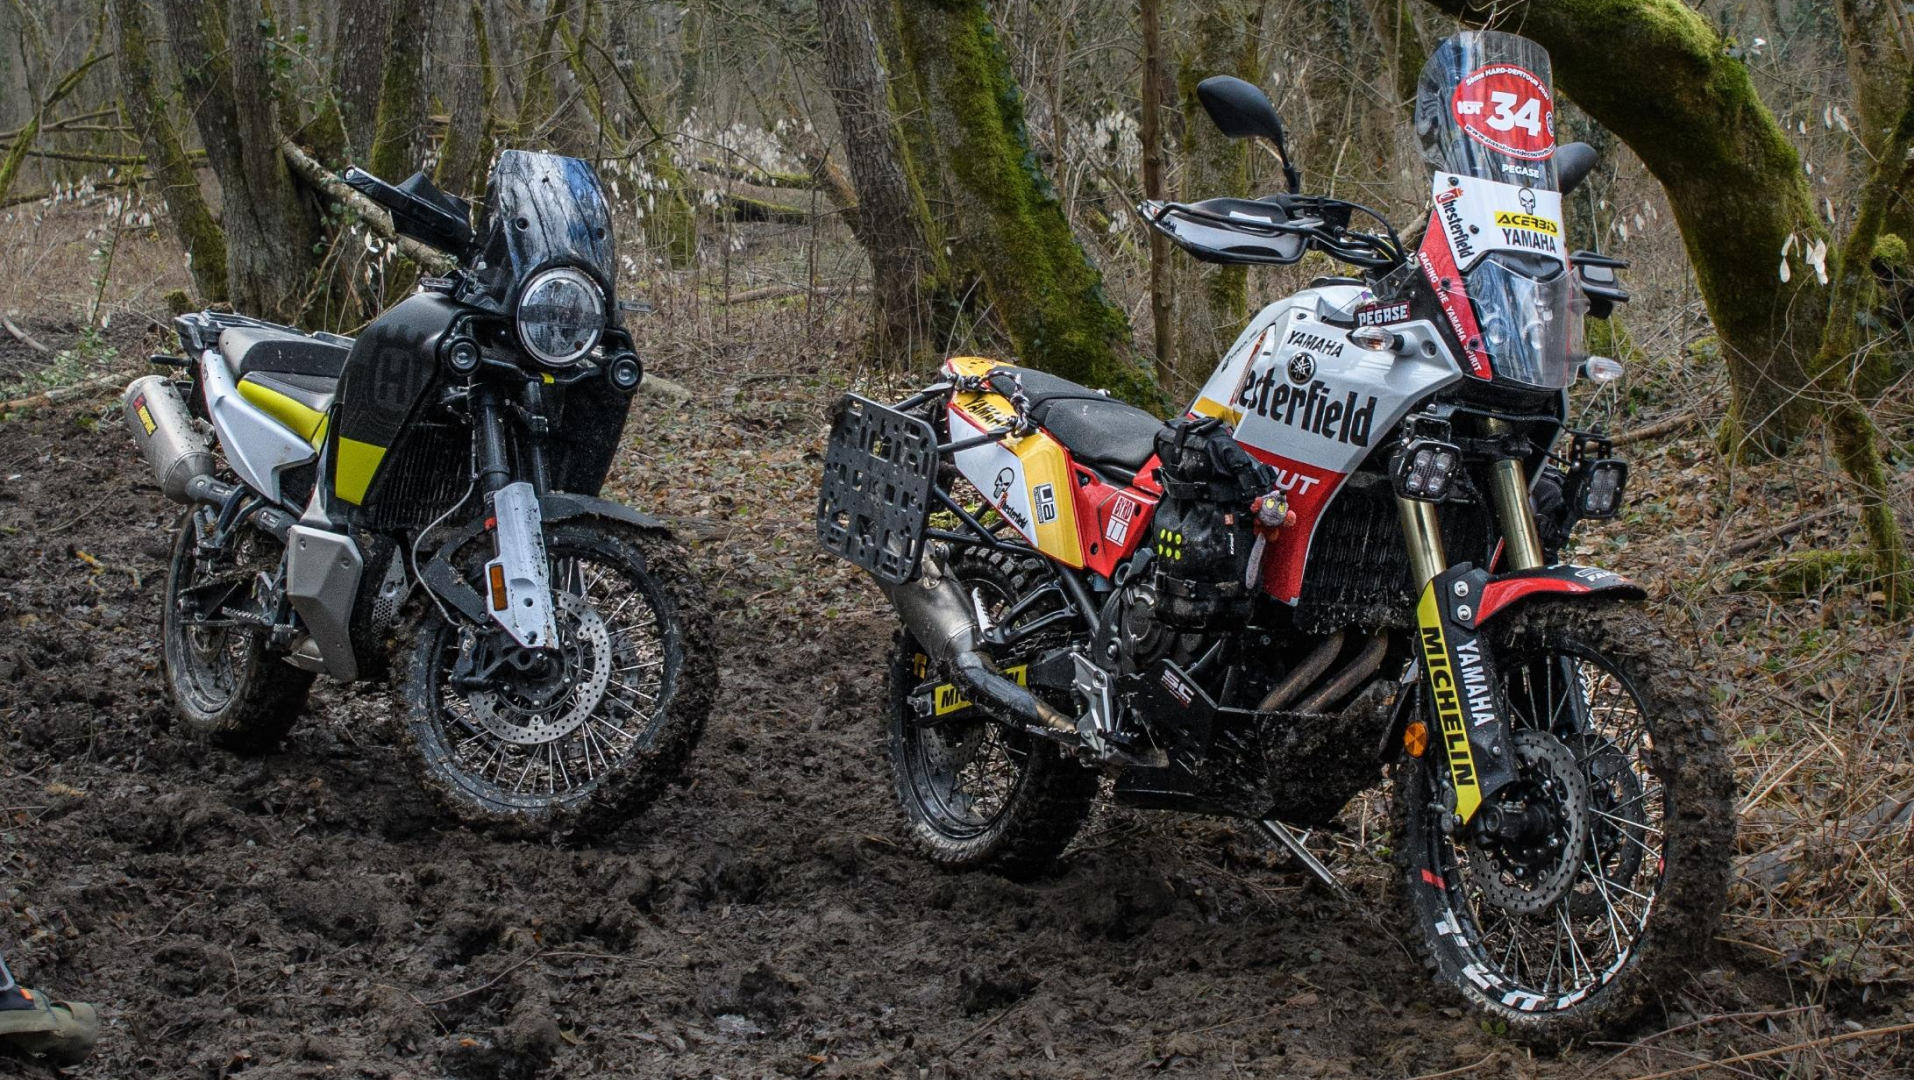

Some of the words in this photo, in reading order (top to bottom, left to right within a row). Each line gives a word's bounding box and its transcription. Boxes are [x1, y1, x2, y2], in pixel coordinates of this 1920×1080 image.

[1485, 91, 1541, 137] 34
[1501, 163, 1540, 179] PEGASE
[1435, 187, 1475, 260] Chesterfield
[1502, 228, 1557, 254] YAMAHA
[1358, 304, 1409, 327] PEGASE
[1419, 252, 1439, 284] RACING
[1436, 287, 1449, 310] THE
[1445, 305, 1467, 342] YAMAHA
[1286, 329, 1345, 359] YAMAHA
[1455, 638, 1495, 727] YAMAHA
[1421, 626, 1476, 786] MICHELIN
